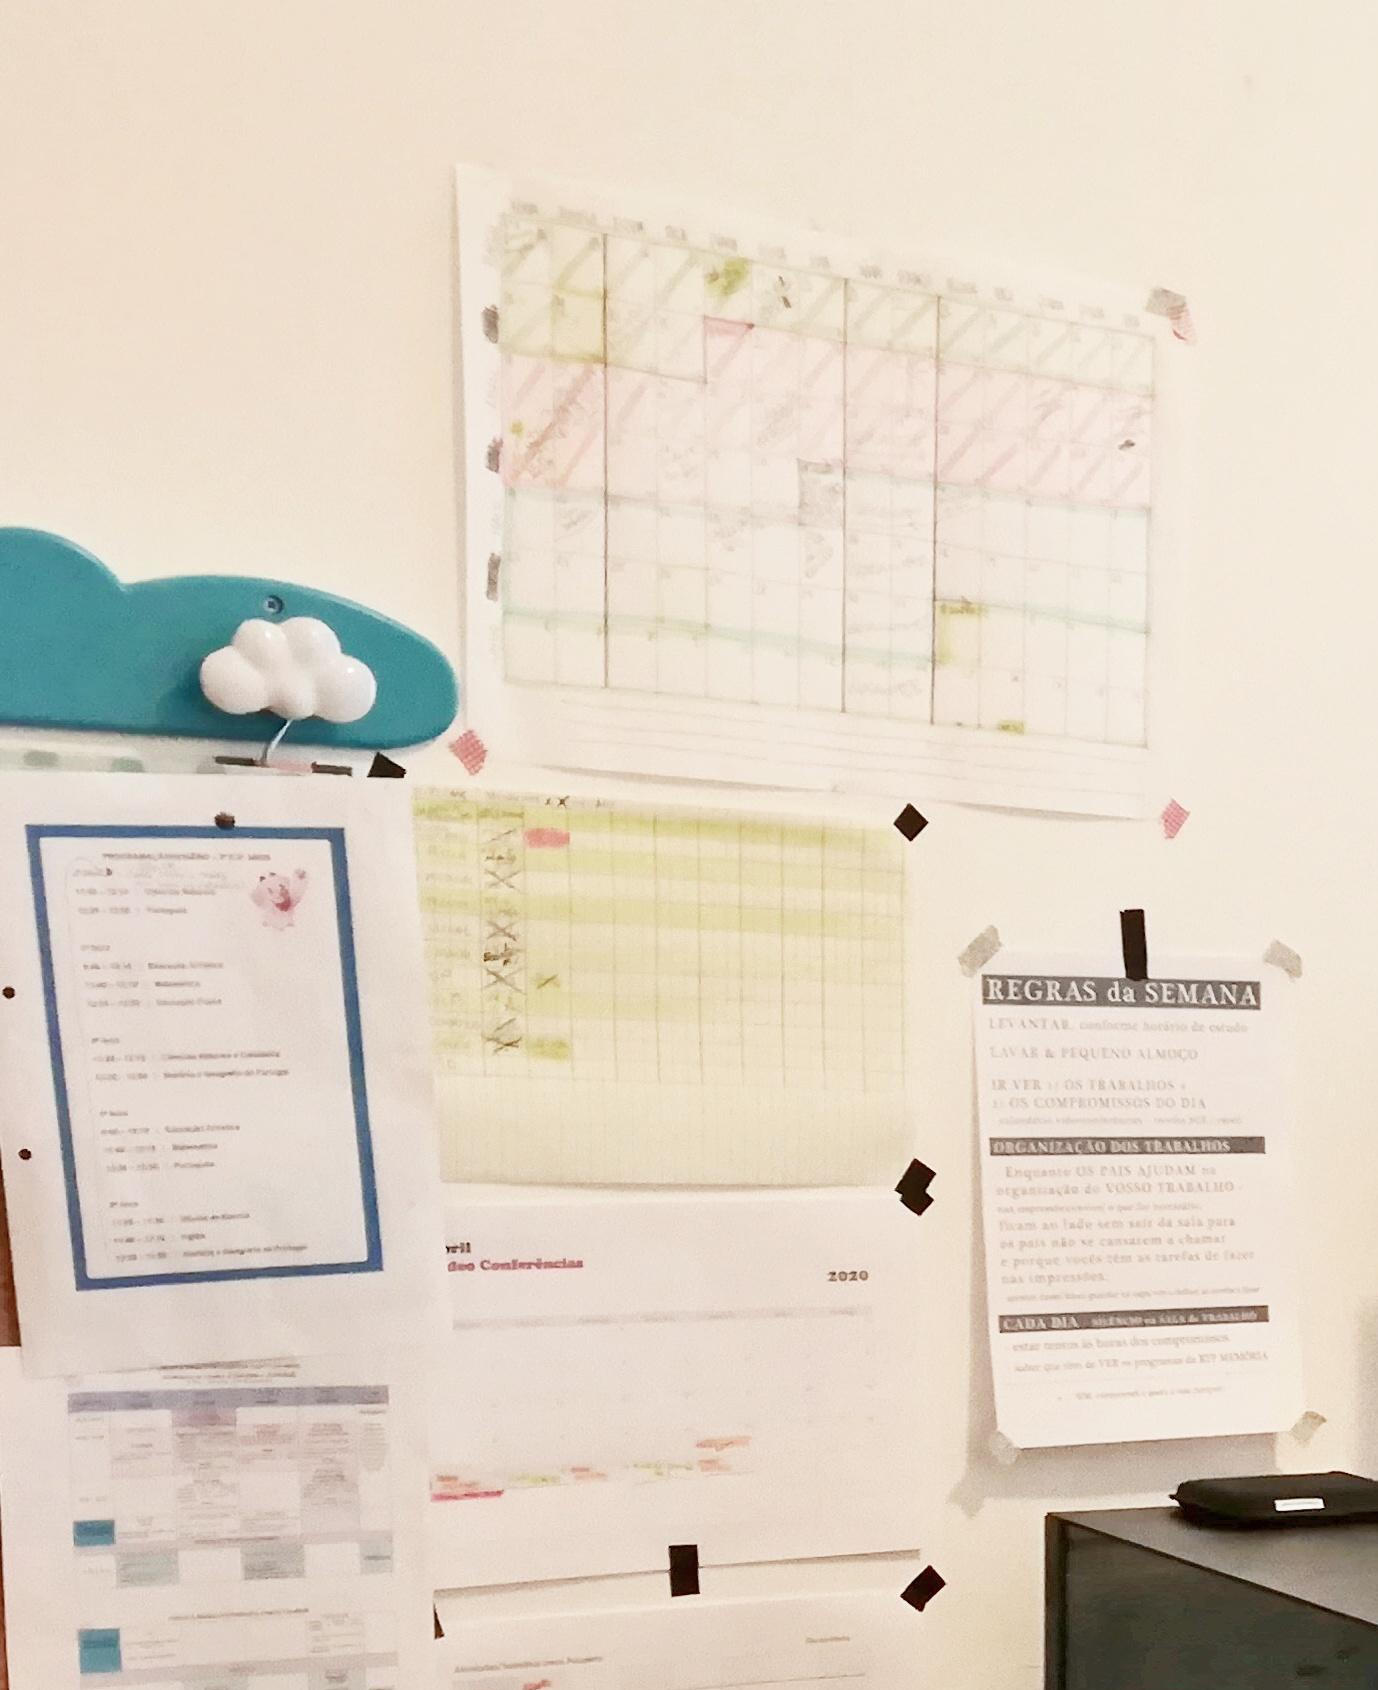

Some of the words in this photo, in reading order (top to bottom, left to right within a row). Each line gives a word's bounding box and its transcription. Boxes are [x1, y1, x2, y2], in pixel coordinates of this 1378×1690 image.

[986, 978, 1097, 1001] REGRAS
[1107, 980, 1136, 1003] da
[1144, 982, 1257, 1006] SEMANA
[989, 1046, 1039, 1058] LAVAR
[1061, 1047, 1132, 1061] PEQUENO
[1139, 1048, 1199, 1062] ALMOÇO
[991, 1079, 1007, 1090] IR
[1011, 1079, 1041, 1090] VER
[1063, 1079, 1082, 1090] OS
[1089, 1079, 1176, 1091] TRABALHOS
[1008, 1097, 1029, 1109] OS
[1033, 1096, 1151, 1109] COMPROMISSOS
[1154, 1097, 1176, 1109] DO
[1181, 1097, 1206, 1109] DIA
[992, 1139, 1107, 1154] ORGANIZAÇÃO
[1110, 1140, 1140, 1153] DOS
[1144, 1139, 1231, 1153] TRABALHOS
[1075, 1165, 1096, 1177] OS
[1100, 1165, 1132, 1177] PAIS
[1137, 1165, 1196, 1178] AJUDAM
[996, 1183, 1079, 1199] organização
[1105, 1181, 1152, 1194] VOSSO
[1157, 1181, 1235, 1194] TRABALHO
[1207, 1217, 1236, 1231] para
[480, 1257, 584, 1271] Conferências
[1013, 1257, 1060, 1270] porque
[827, 1269, 869, 1282] 2020
[1002, 1317, 1048, 1331] CADA
[1050, 1315, 1080, 1330] DIA
